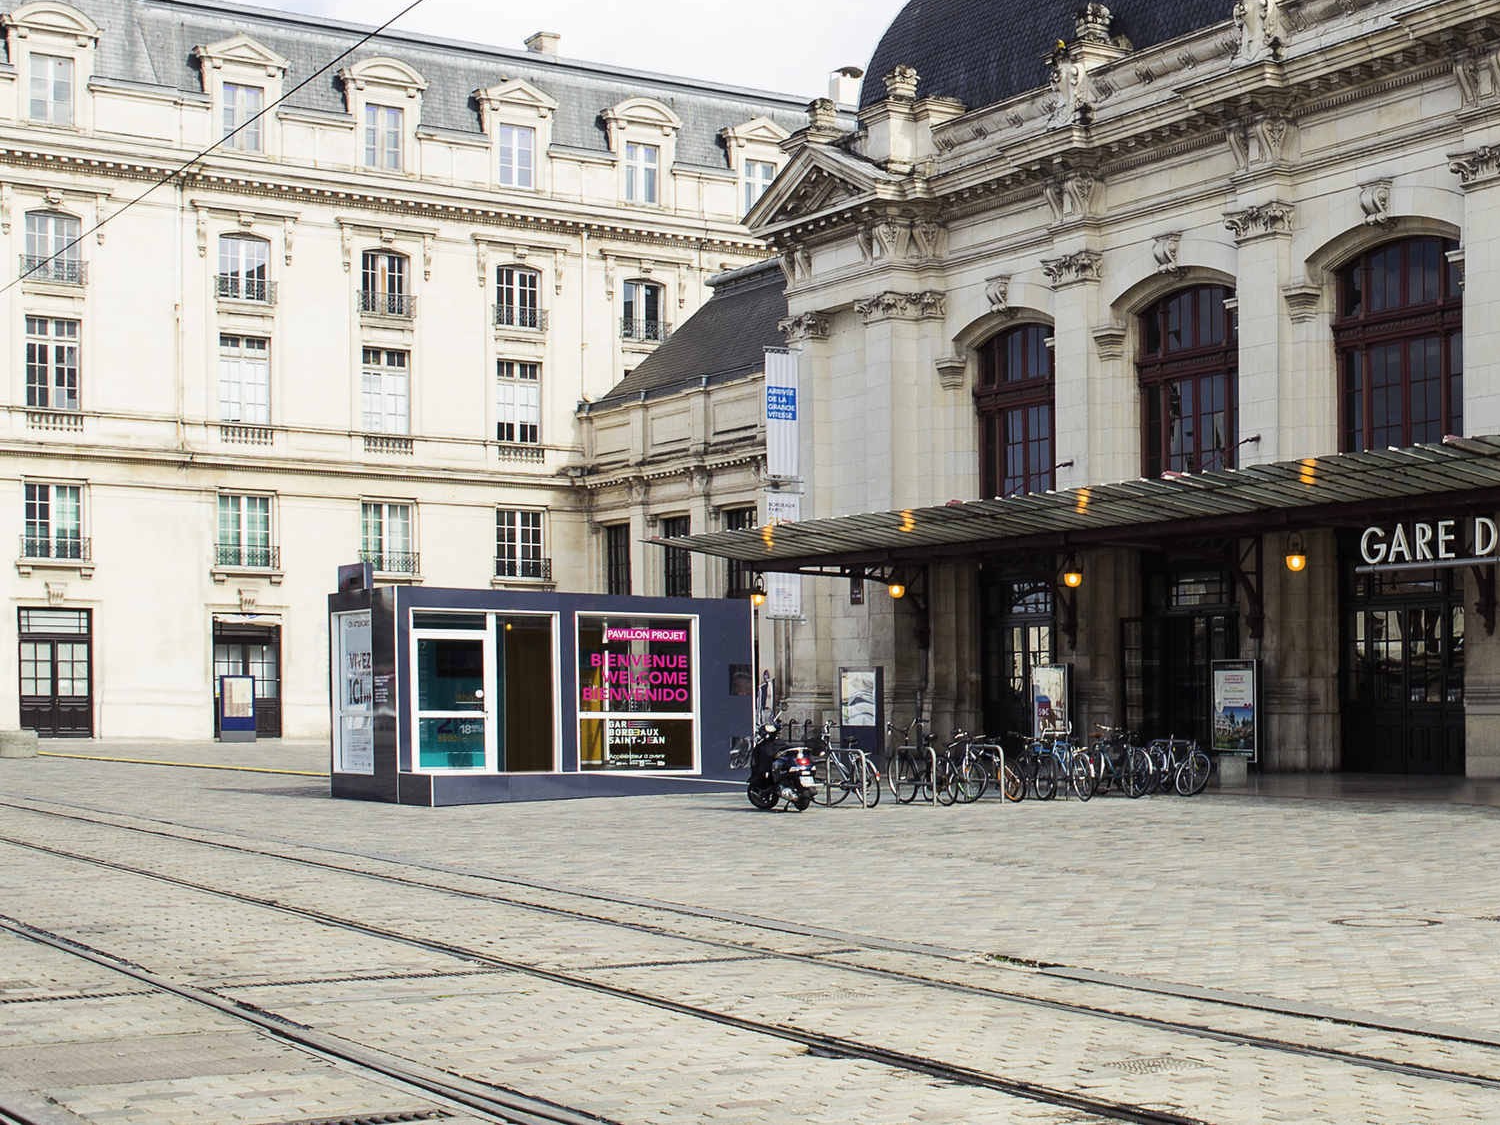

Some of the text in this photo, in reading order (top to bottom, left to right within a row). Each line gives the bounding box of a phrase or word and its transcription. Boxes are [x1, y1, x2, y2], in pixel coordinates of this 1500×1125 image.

[778, 396, 787, 404] LA
[768, 403, 795, 412] GRANDE
[1360, 520, 1456, 564] GARE
[607, 630, 684, 640] PAVILLON PROJET
[349, 652, 372, 669] VIVEZ
[591, 653, 688, 668] BIENVENUE
[602, 671, 688, 685] WELCOME
[582, 688, 689, 702] BIENVENIDO
[609, 728, 659, 736] BORDEAUX
[609, 736, 666, 744] SAINT-JEAN
